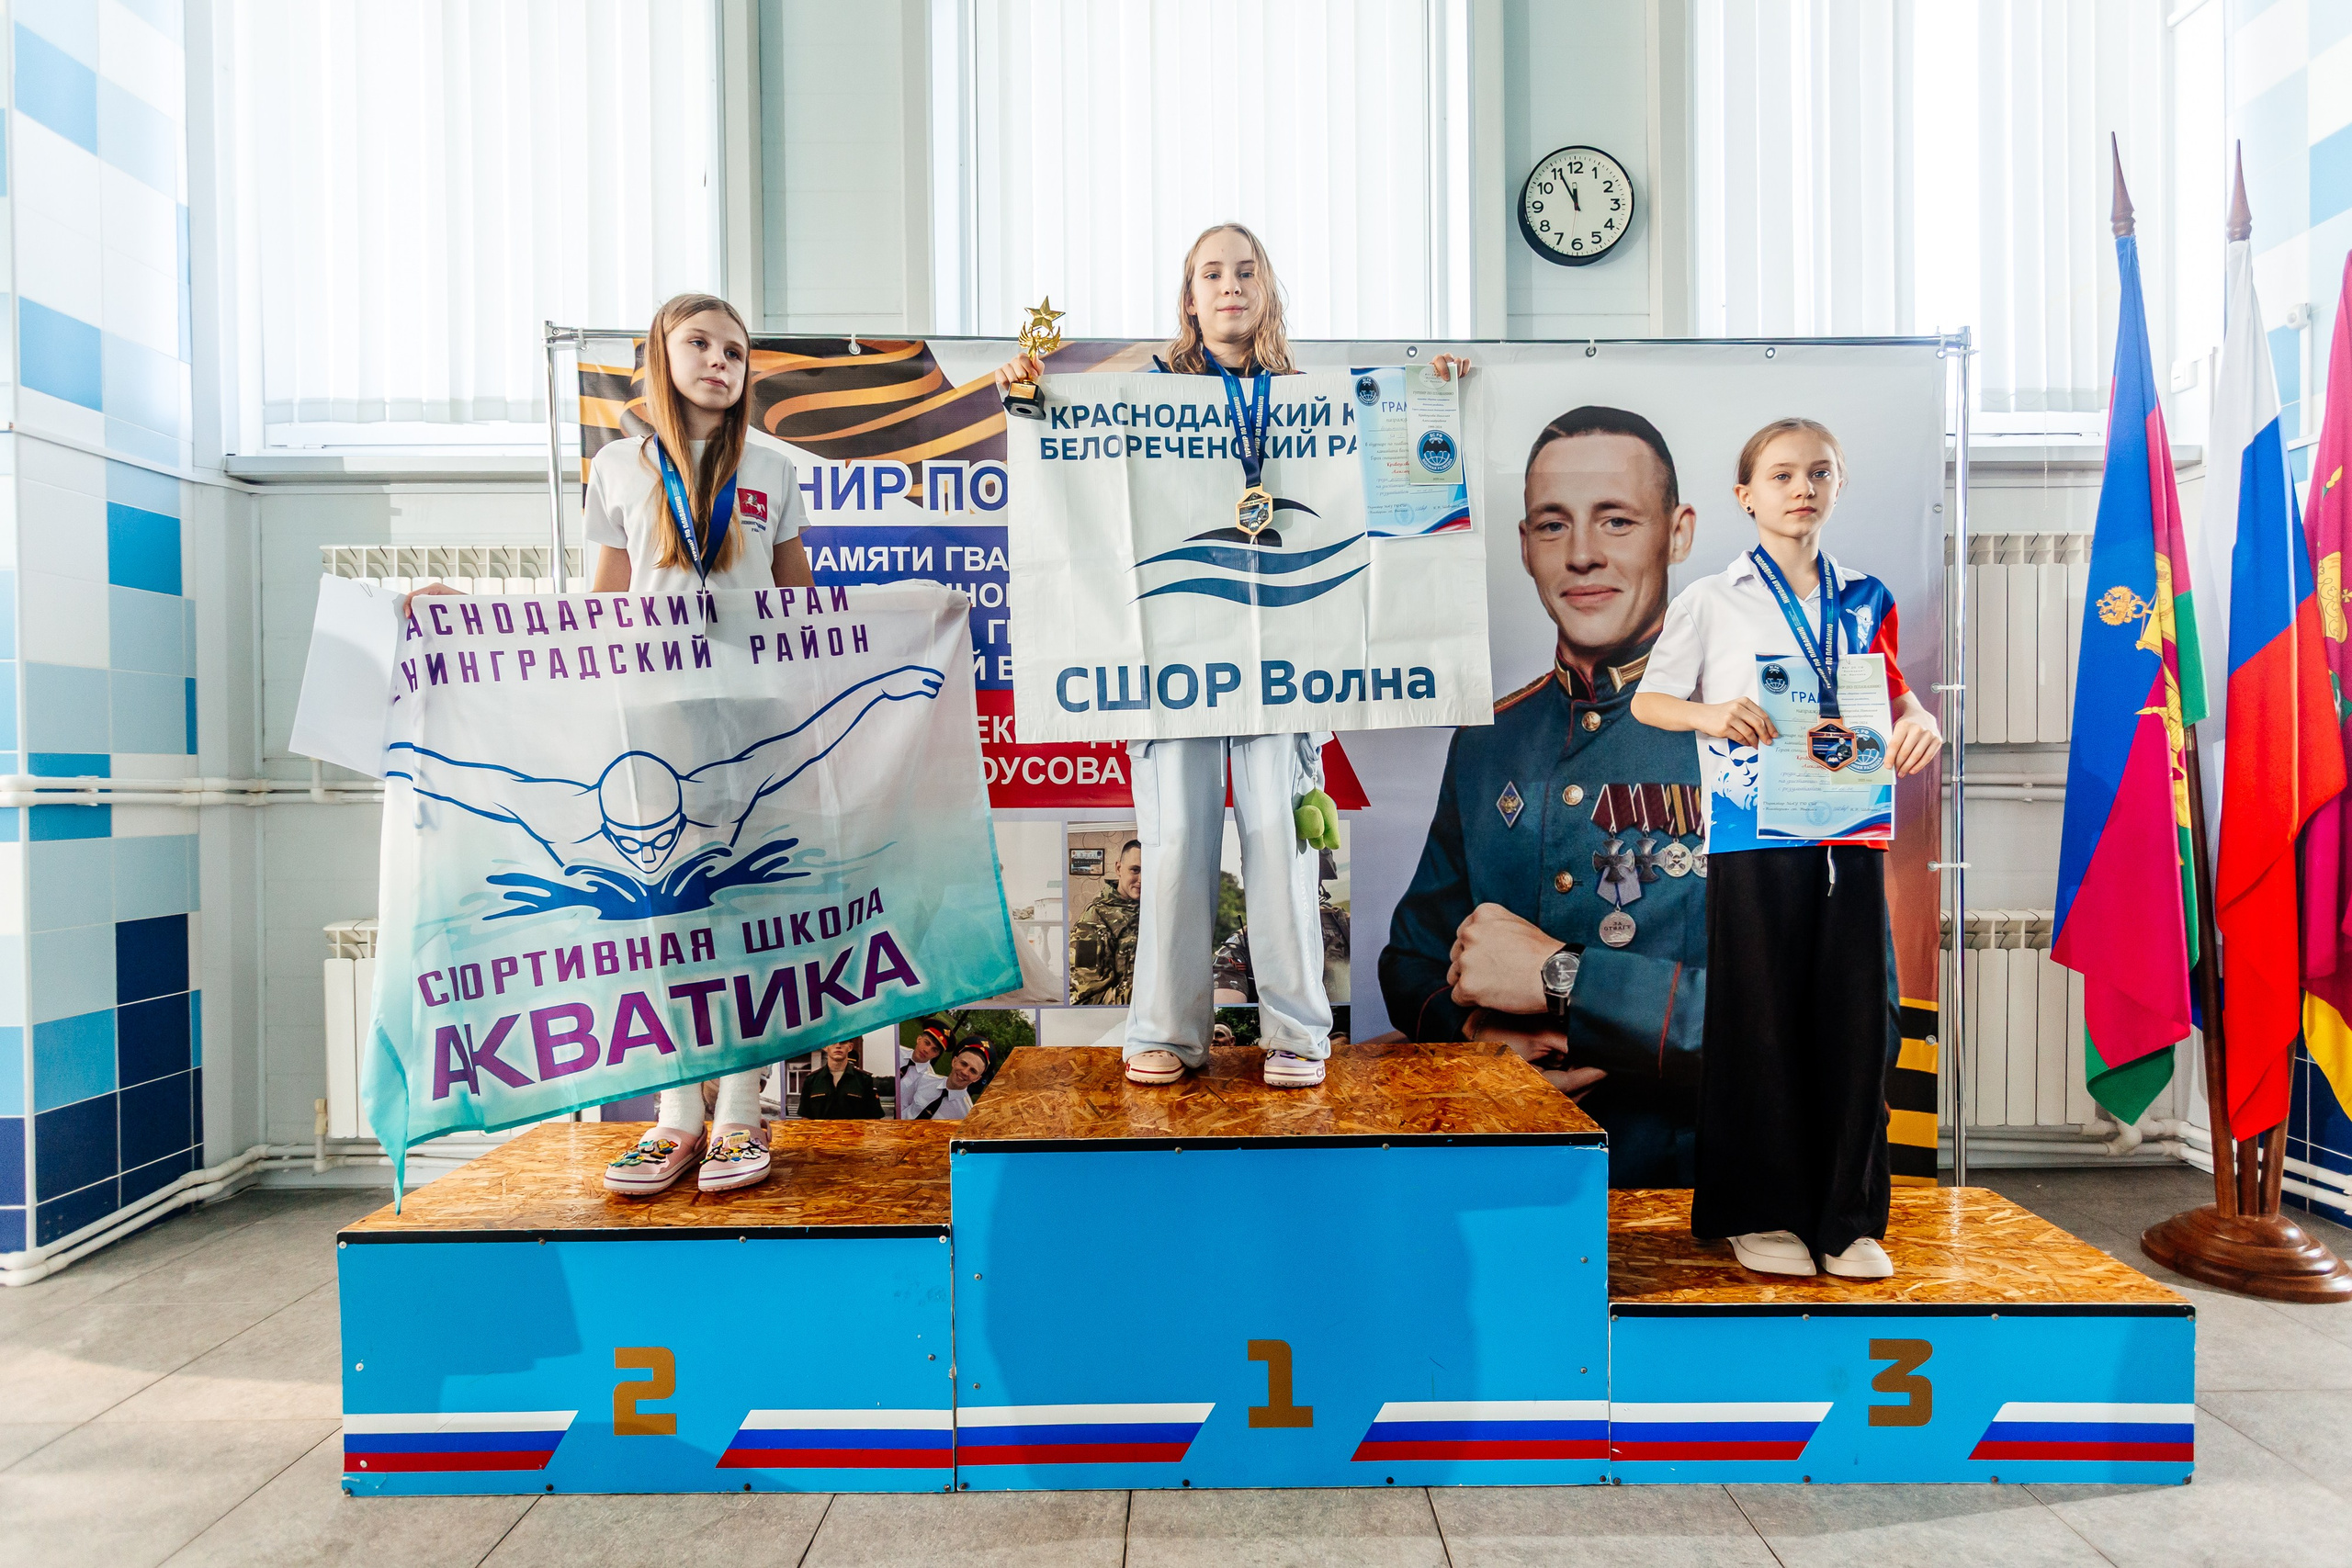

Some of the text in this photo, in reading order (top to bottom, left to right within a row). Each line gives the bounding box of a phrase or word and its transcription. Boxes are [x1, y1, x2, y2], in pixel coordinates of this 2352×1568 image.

[1551, 168, 1563, 180] 11
[1567, 162, 1584, 174] 12
[1591, 166, 1598, 179] 1
[1537, 182, 1554, 195] 10
[1602, 180, 1613, 193] 2
[1532, 200, 1544, 213] 9
[1610, 198, 1621, 211] 3
[1539, 220, 1551, 232] 8
[1603, 218, 1614, 231] 4
[1554, 232, 1564, 245] 7
[1591, 231, 1602, 244] 5
[1571, 238, 1583, 251] 6
[1051, 396, 1330, 432] КРАСНОДАРКИЙ
[795, 466, 1008, 512] НИР ПО
[406, 590, 718, 641] АСНОДАРСКИЙ
[396, 624, 870, 698] НИНГРАДСКИЙ РАЙОН
[1056, 663, 1242, 713] СШОР
[1261, 660, 1437, 706] Волна
[981, 756, 1125, 784] ОУСОВА
[741, 886, 885, 954] ШКОЛА
[433, 931, 921, 1100] АКВАТИКА
[1247, 1338, 1314, 1428] 1
[1868, 1338, 1933, 1427] 3
[613, 1347, 677, 1436] 2
